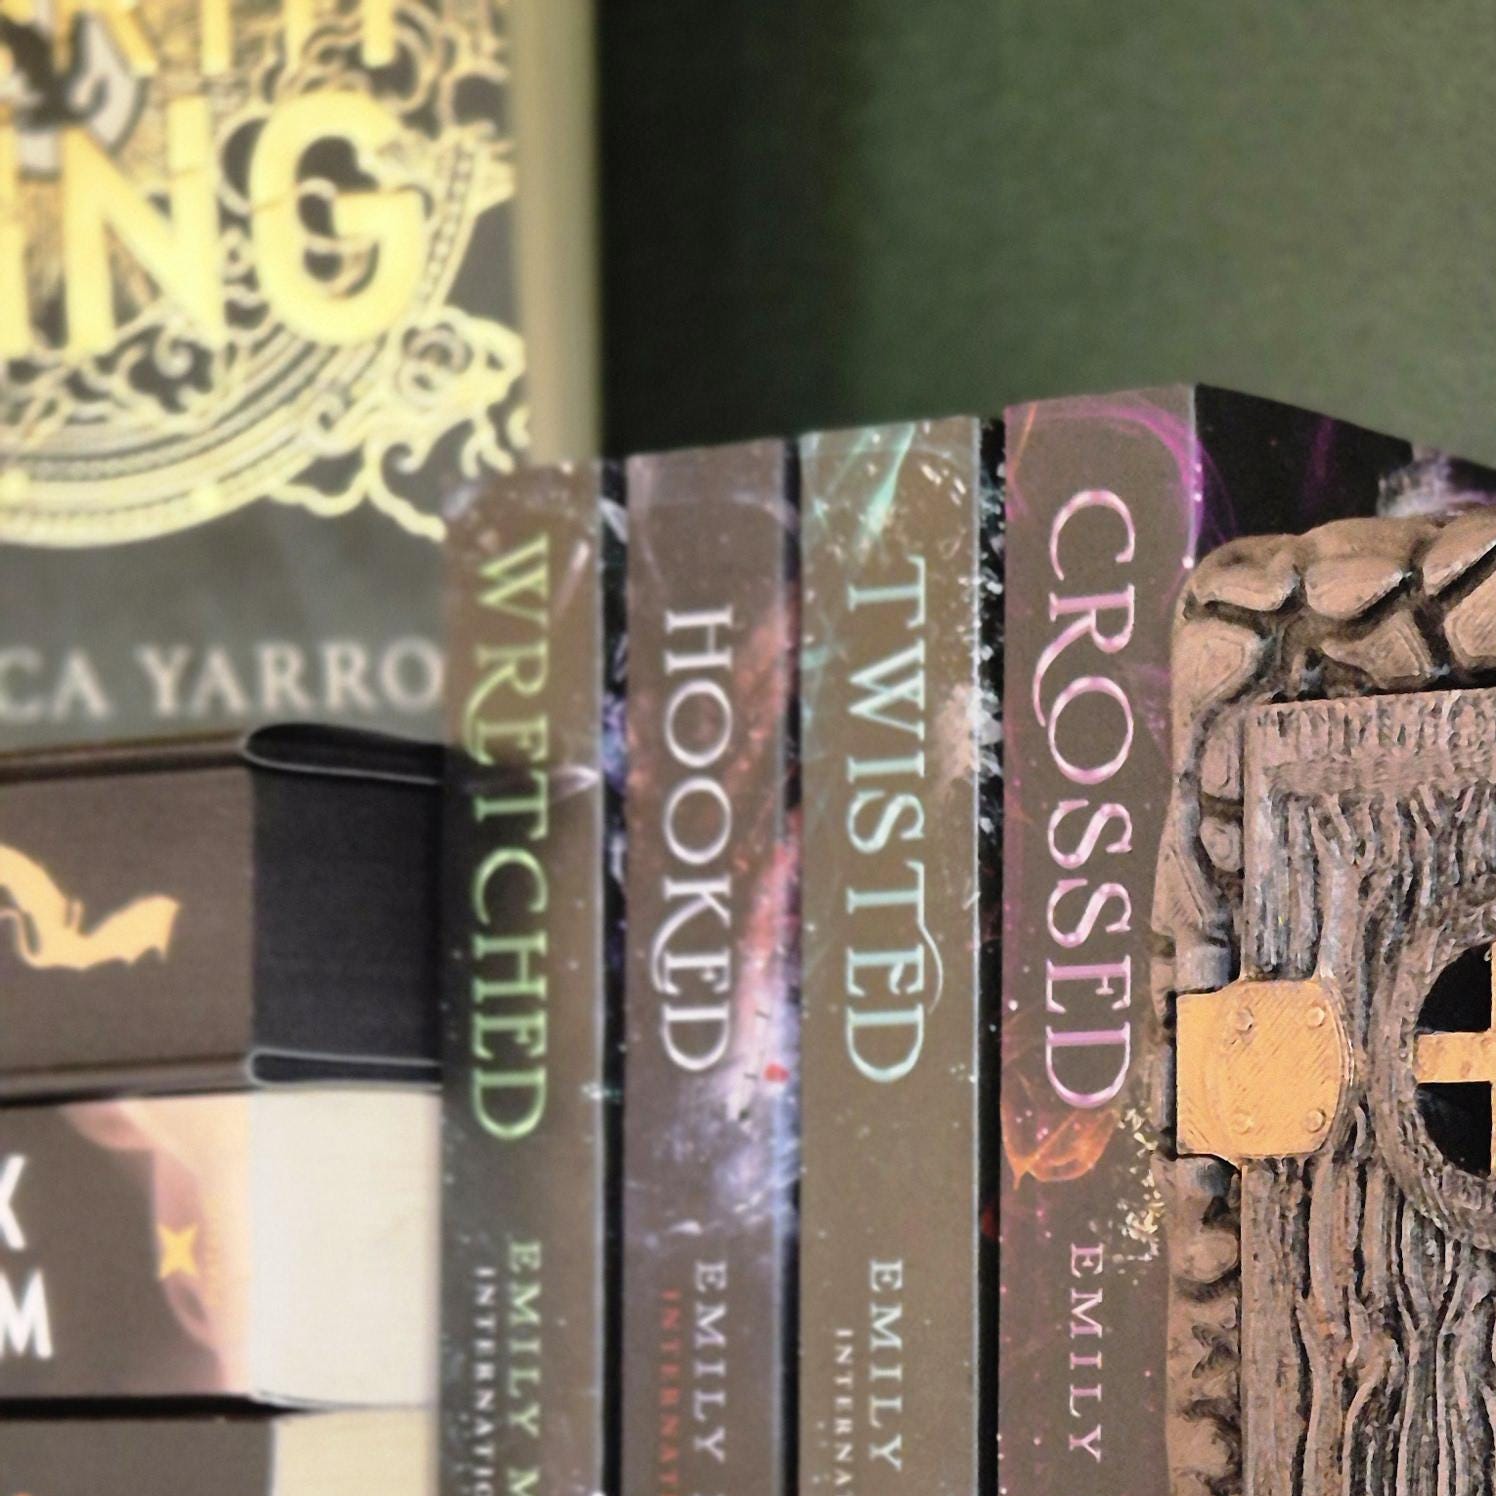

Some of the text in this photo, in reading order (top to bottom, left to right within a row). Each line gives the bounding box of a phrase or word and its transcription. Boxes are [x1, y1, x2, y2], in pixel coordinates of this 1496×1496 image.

[463, 534, 548, 1139] WRETCHED
[650, 606, 732, 1070] HOOKED
[846, 555, 942, 1082] TWISTED
[1033, 489, 1135, 1109] CROSSED
[508, 1241, 540, 1437] EMILY
[692, 1261, 725, 1462] EMILY
[868, 1259, 902, 1471] EMILY
[1069, 1243, 1102, 1463] EMILY
